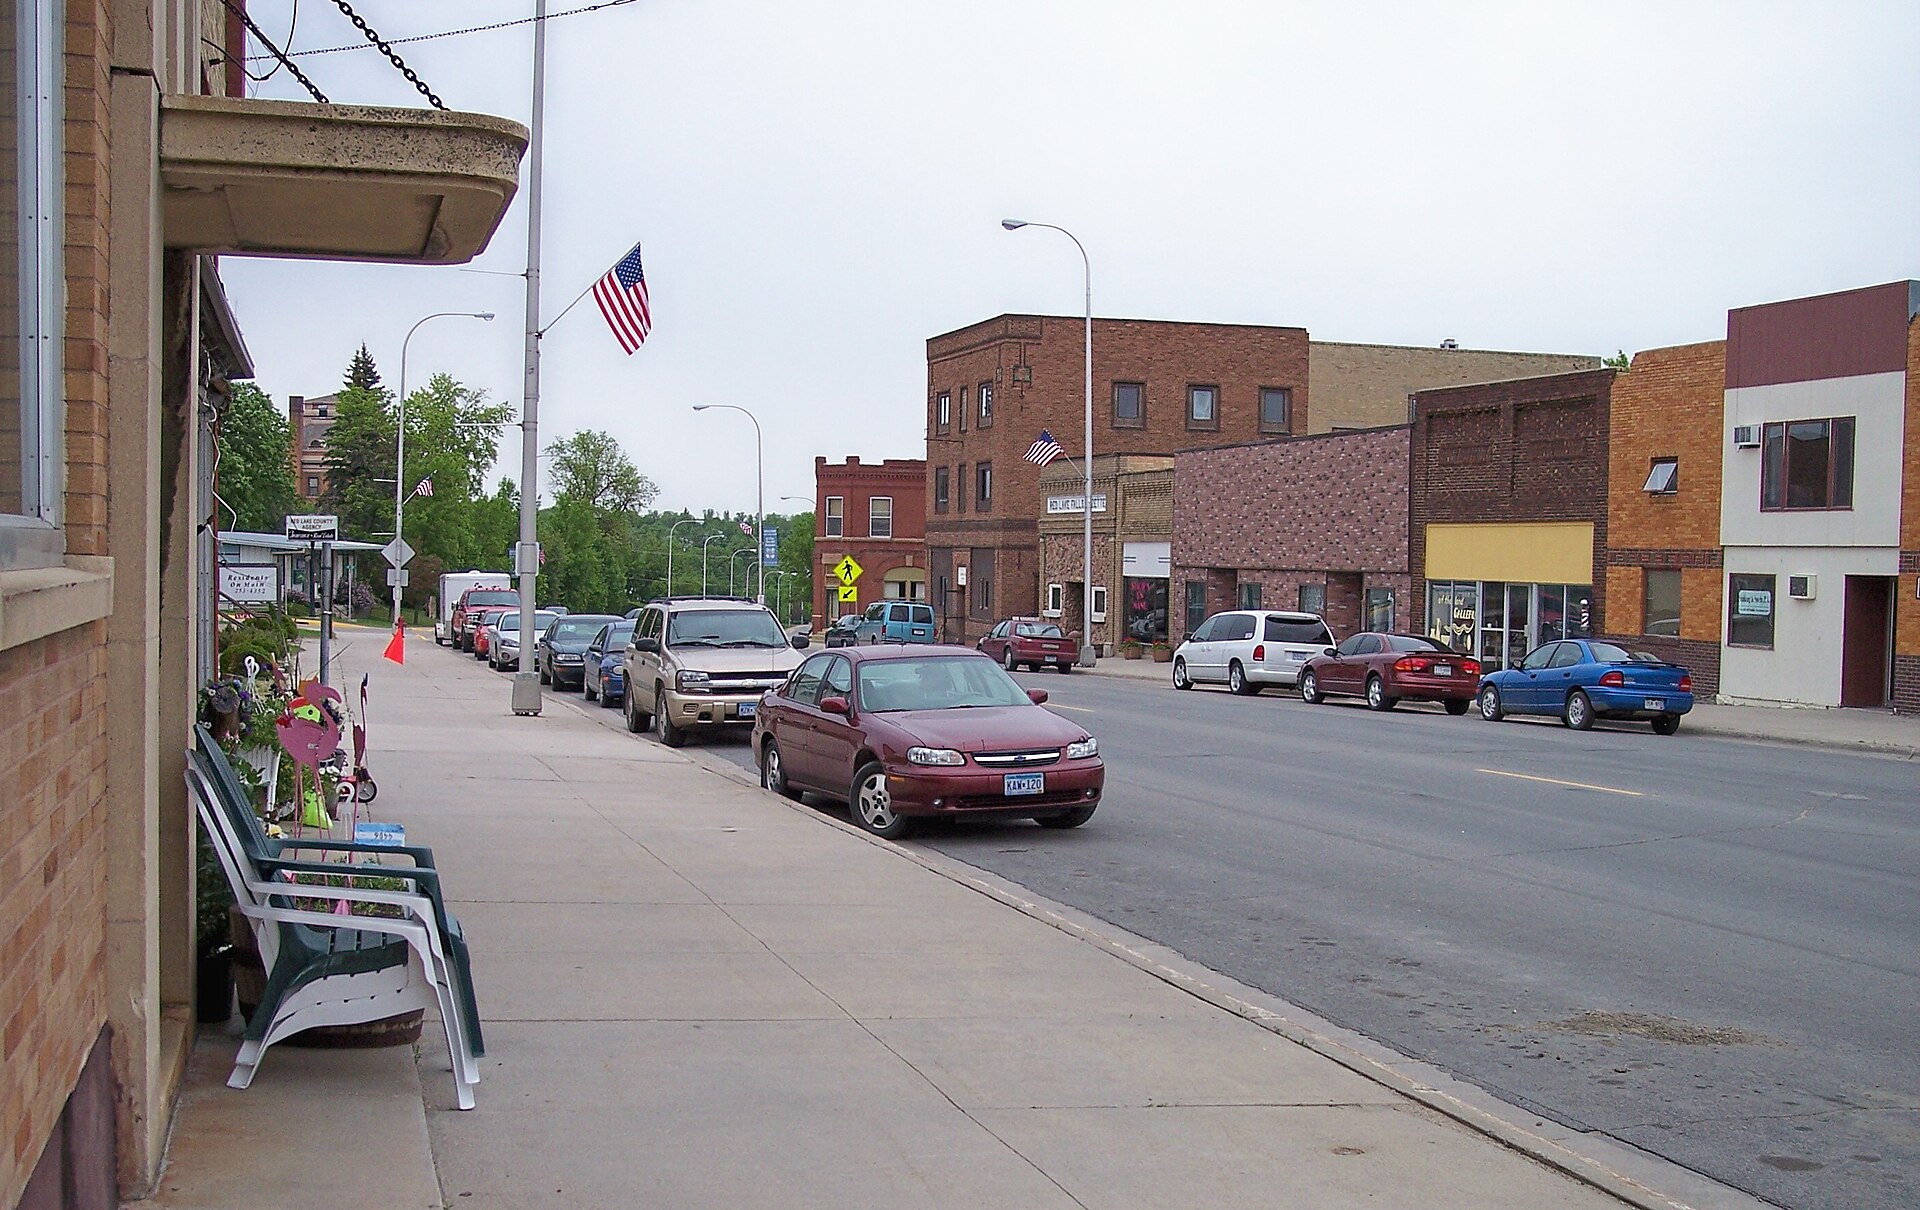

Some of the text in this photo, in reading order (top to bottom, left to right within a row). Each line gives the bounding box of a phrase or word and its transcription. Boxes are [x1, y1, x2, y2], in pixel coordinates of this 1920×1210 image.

[1049, 499, 1058, 510] RED
[1058, 499, 1070, 510] LAKE
[1070, 498, 1085, 509] FALLS
